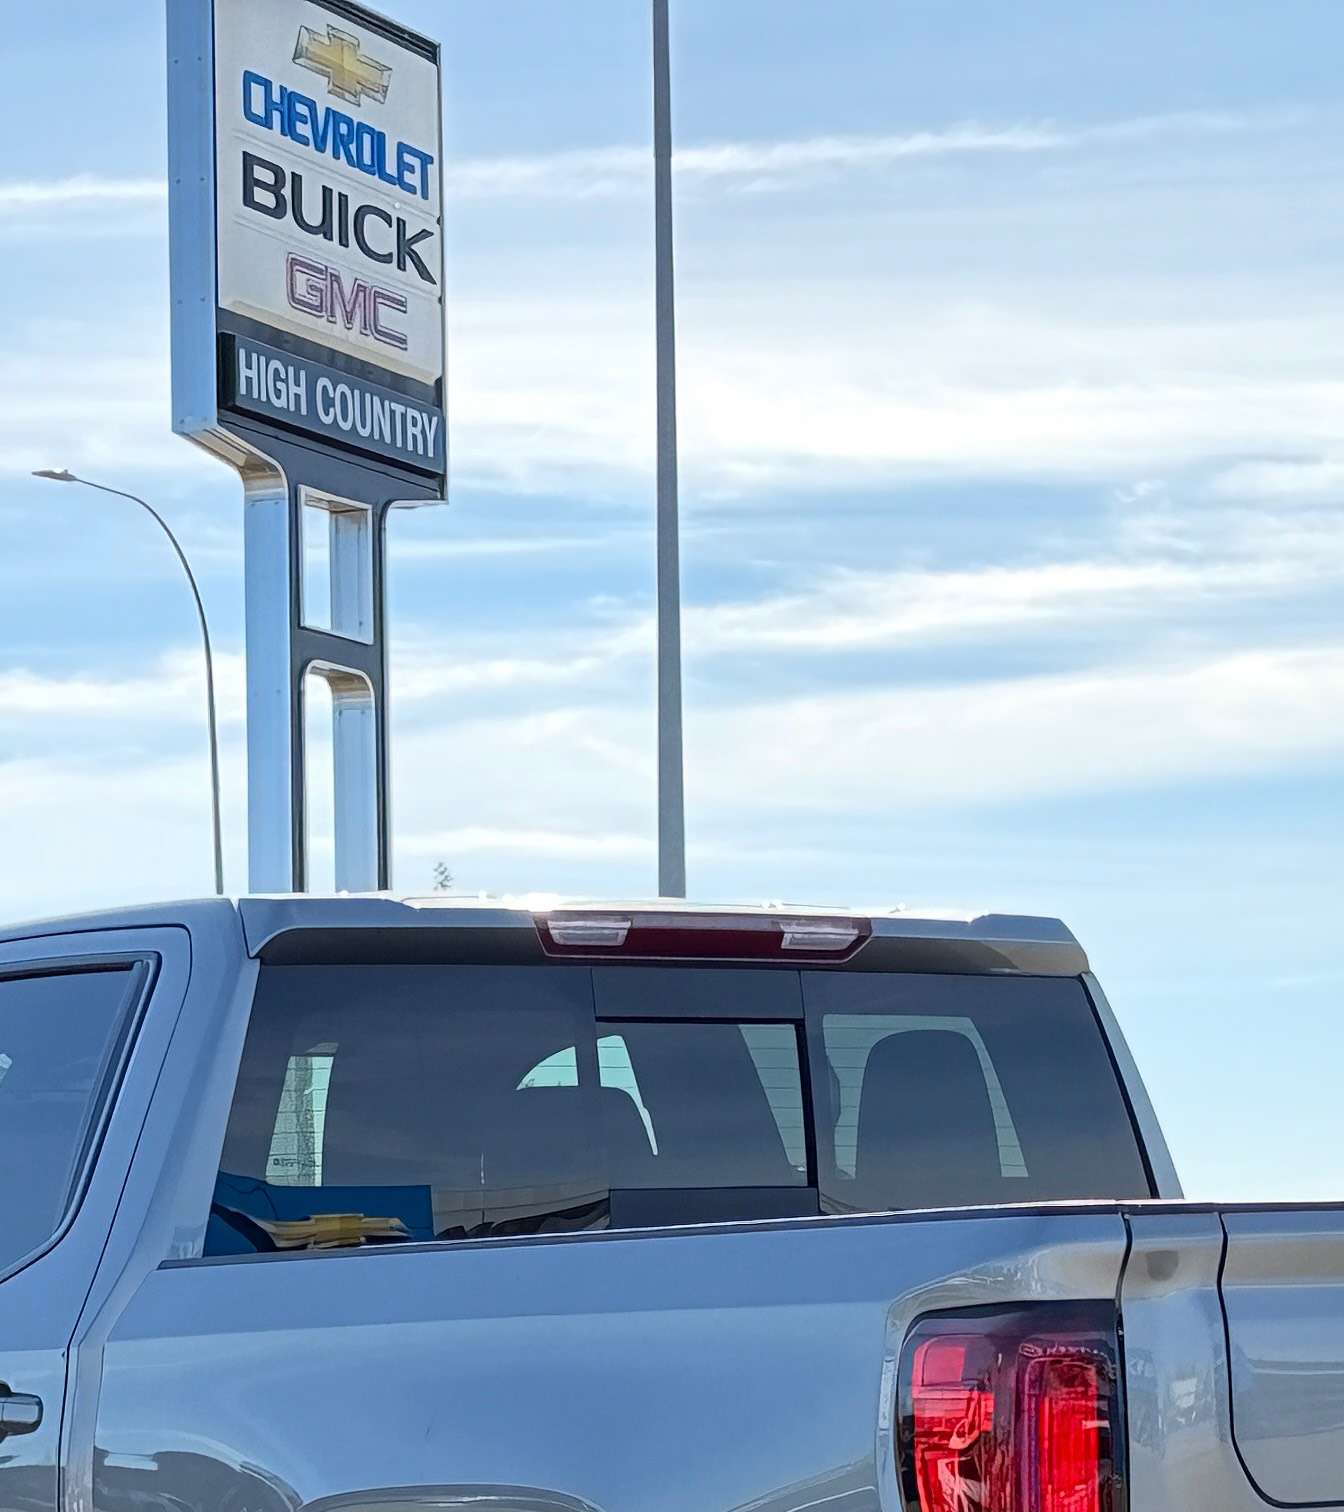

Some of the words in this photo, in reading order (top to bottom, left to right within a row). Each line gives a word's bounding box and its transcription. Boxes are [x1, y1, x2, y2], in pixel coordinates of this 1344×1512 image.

[242, 69, 434, 200] CHEVROLET
[242, 150, 438, 286] BUICK
[285, 251, 408, 351] GMC
[238, 347, 307, 416] HIGH
[316, 377, 439, 458] COUNTRY
